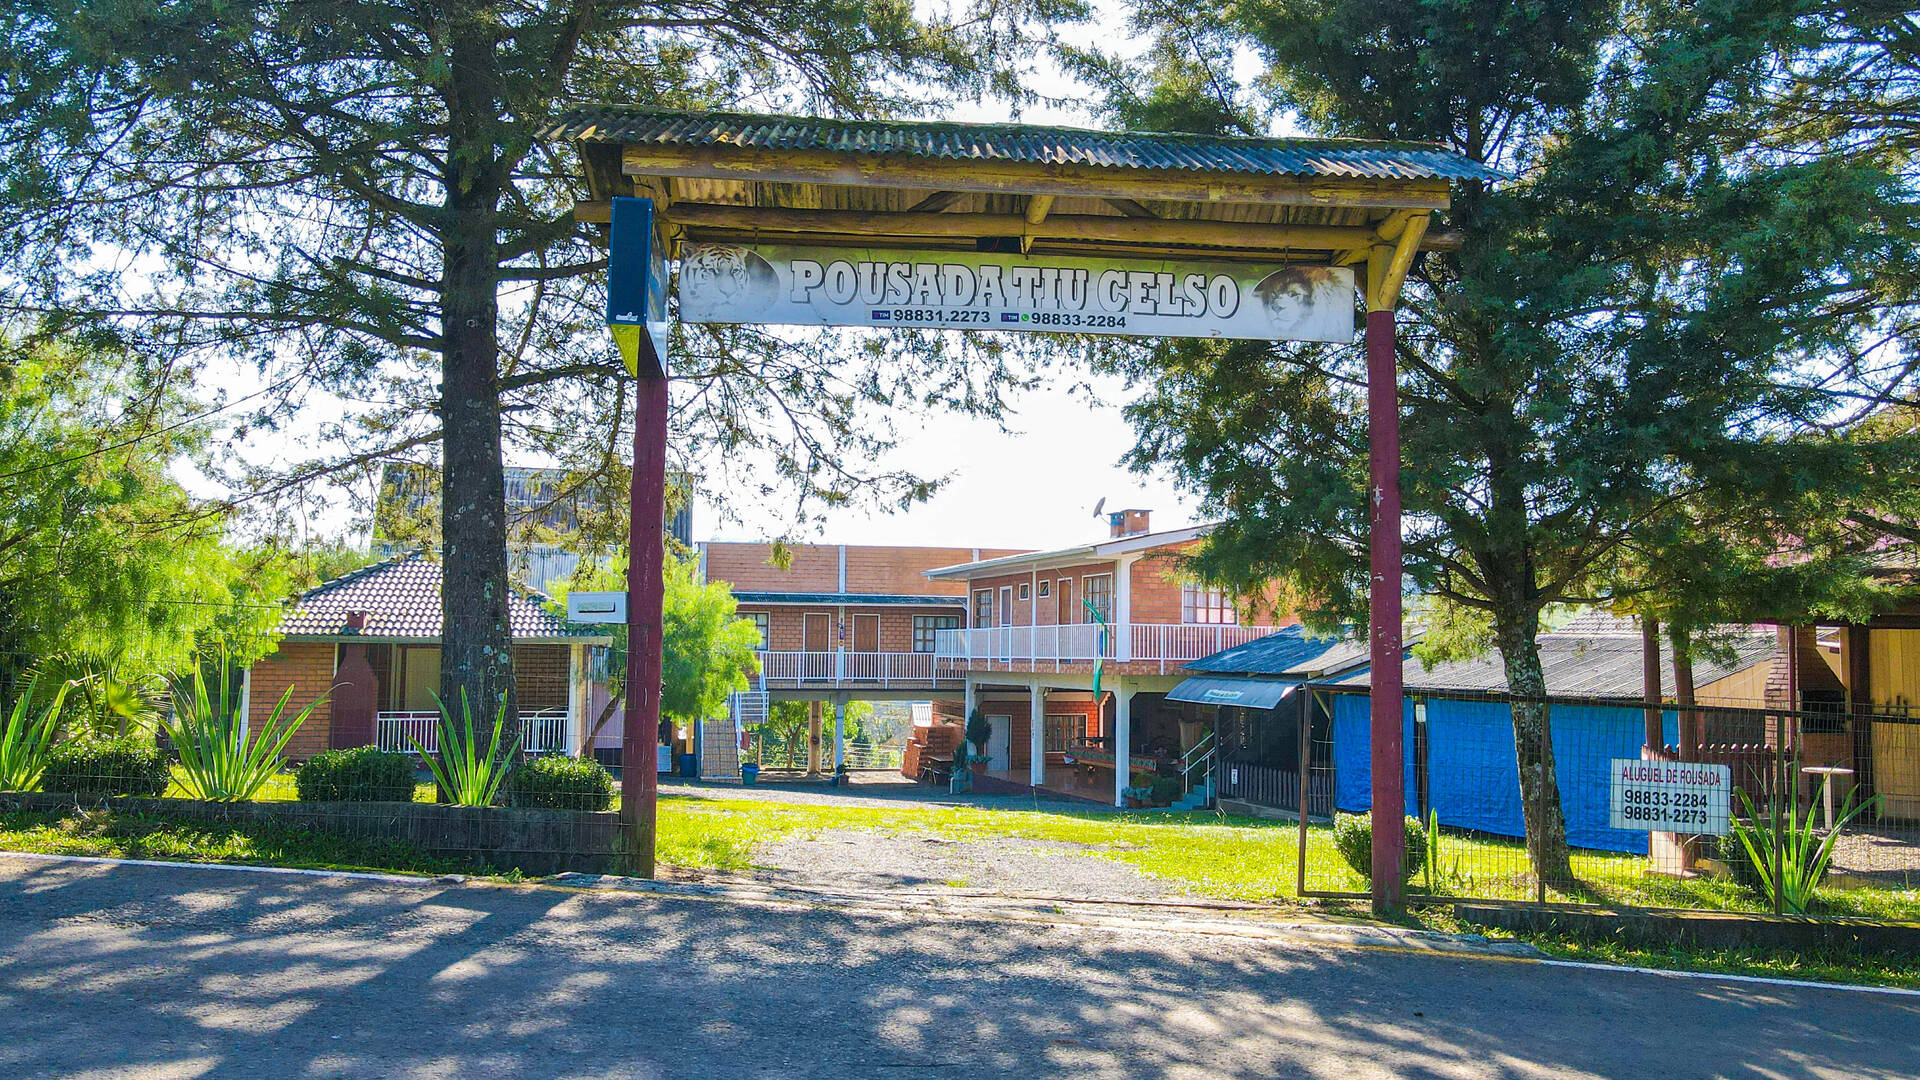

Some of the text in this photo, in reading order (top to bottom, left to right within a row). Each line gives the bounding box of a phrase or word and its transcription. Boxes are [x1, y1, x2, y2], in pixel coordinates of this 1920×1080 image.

[790, 260, 1240, 319] POUSADA TIU CELSO
[894, 309, 991, 323] 98831.2273
[1031, 312, 1127, 328] 98833-2284
[1623, 766, 1721, 786] ALUGUEL DE POUSADA
[1624, 789, 1708, 808] 98833-2284
[1624, 806, 1707, 824] 98831-2273
